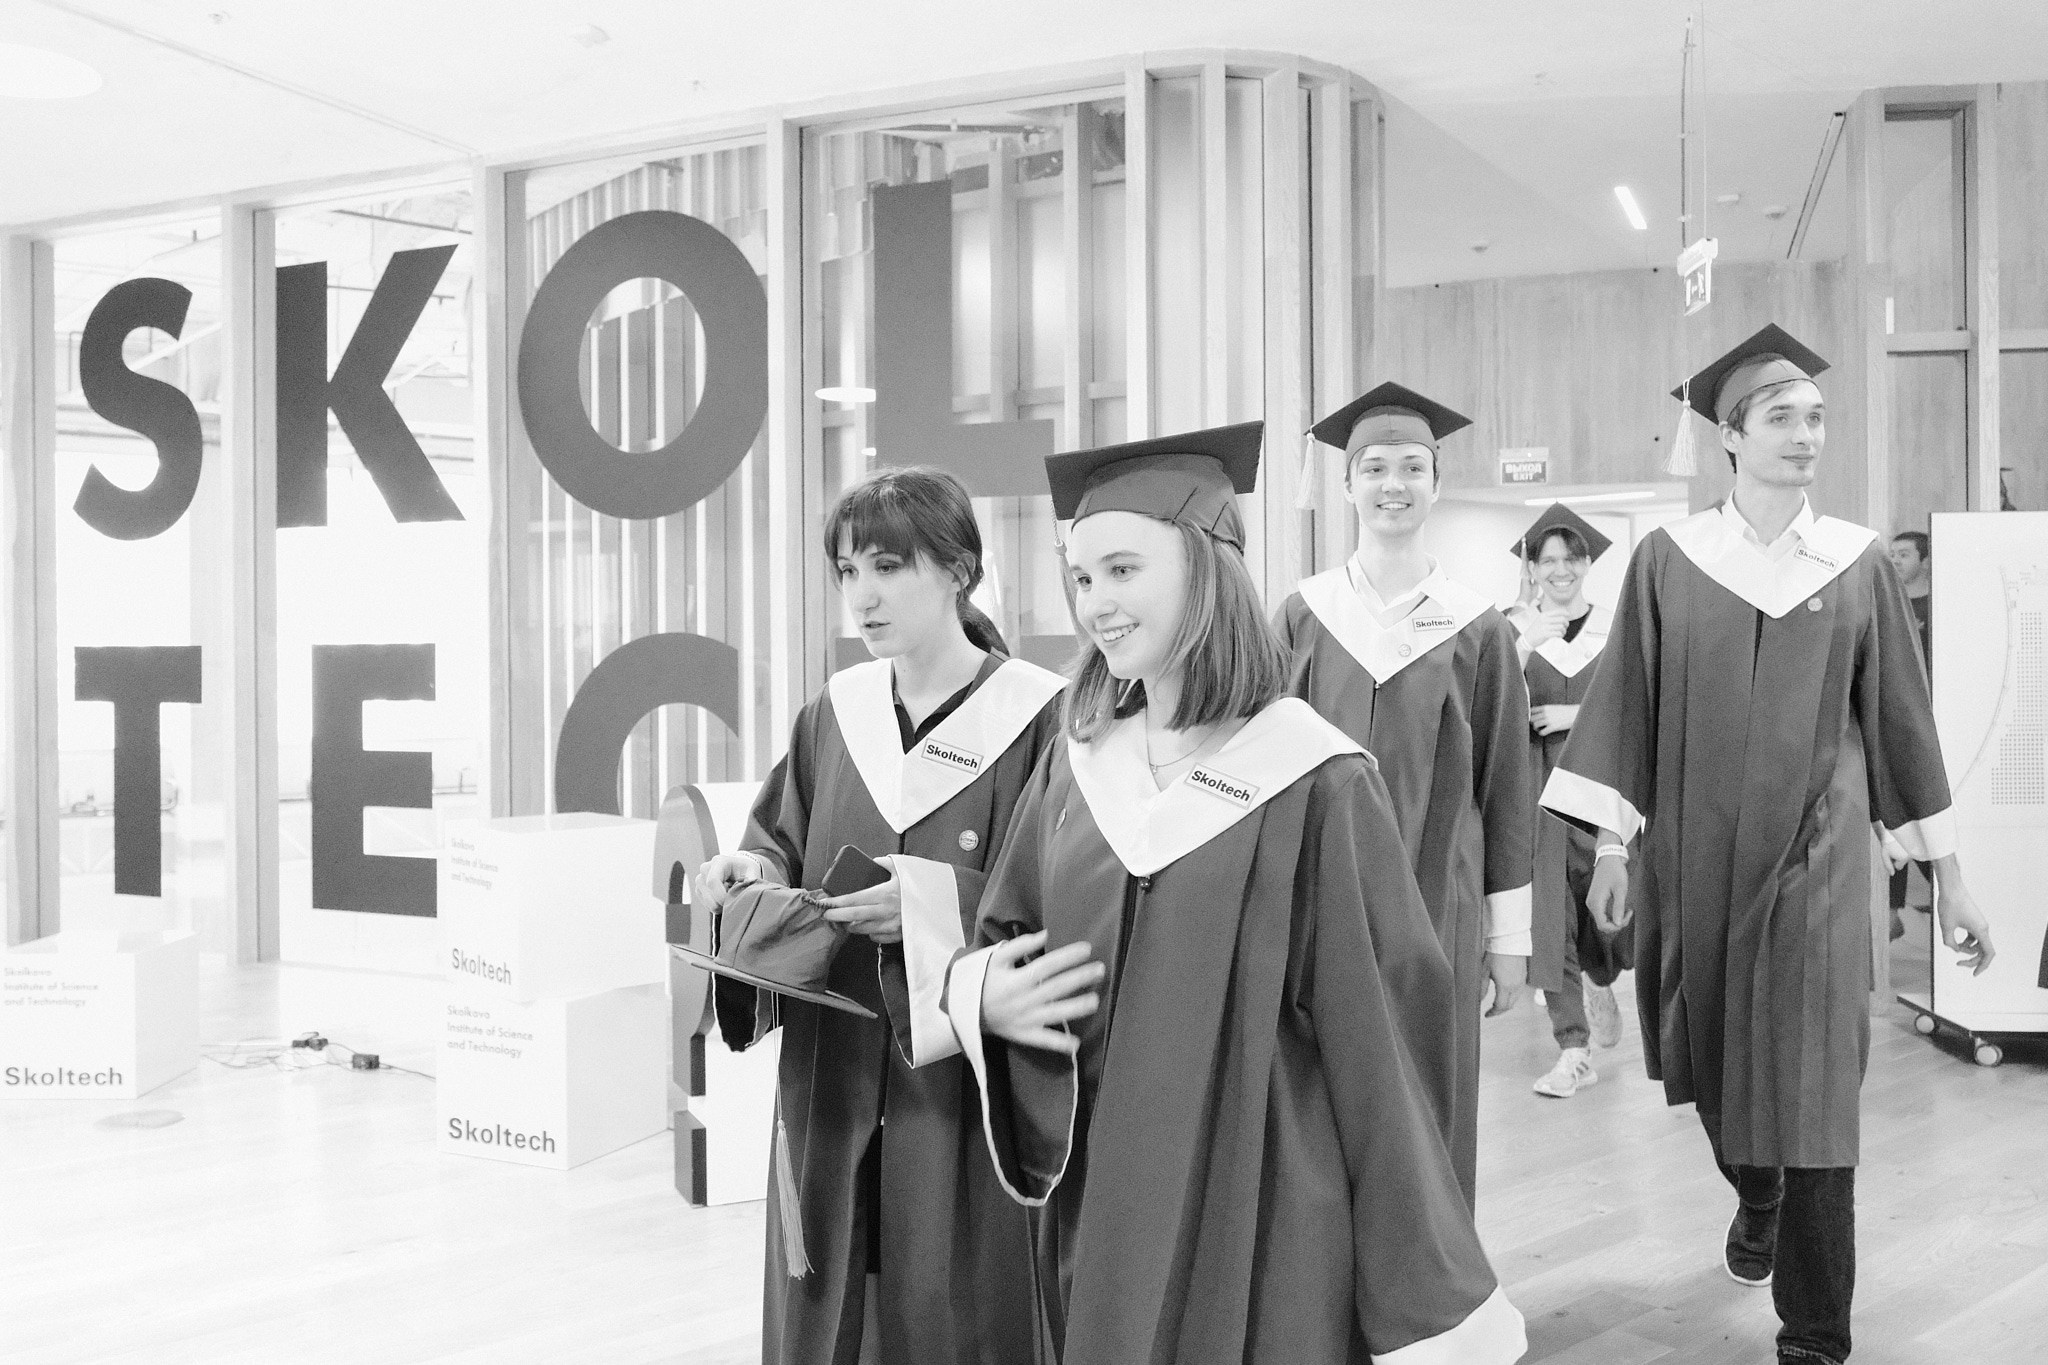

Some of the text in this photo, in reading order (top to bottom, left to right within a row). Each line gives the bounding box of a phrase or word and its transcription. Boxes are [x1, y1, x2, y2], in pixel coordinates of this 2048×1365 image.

[1513, 472, 1534, 481] EXIT
[1798, 549, 1835, 568] Skoltech
[1415, 619, 1453, 628] Skoltech
[926, 744, 978, 769] Skoltech
[1191, 770, 1251, 802] Skoltech
[451, 947, 512, 986] Skoltech
[447, 1022, 534, 1041] Institute of Science
[447, 1040, 522, 1059] and Technology
[5, 1066, 123, 1086] Skoltech
[448, 1117, 556, 1153] Skoltech
